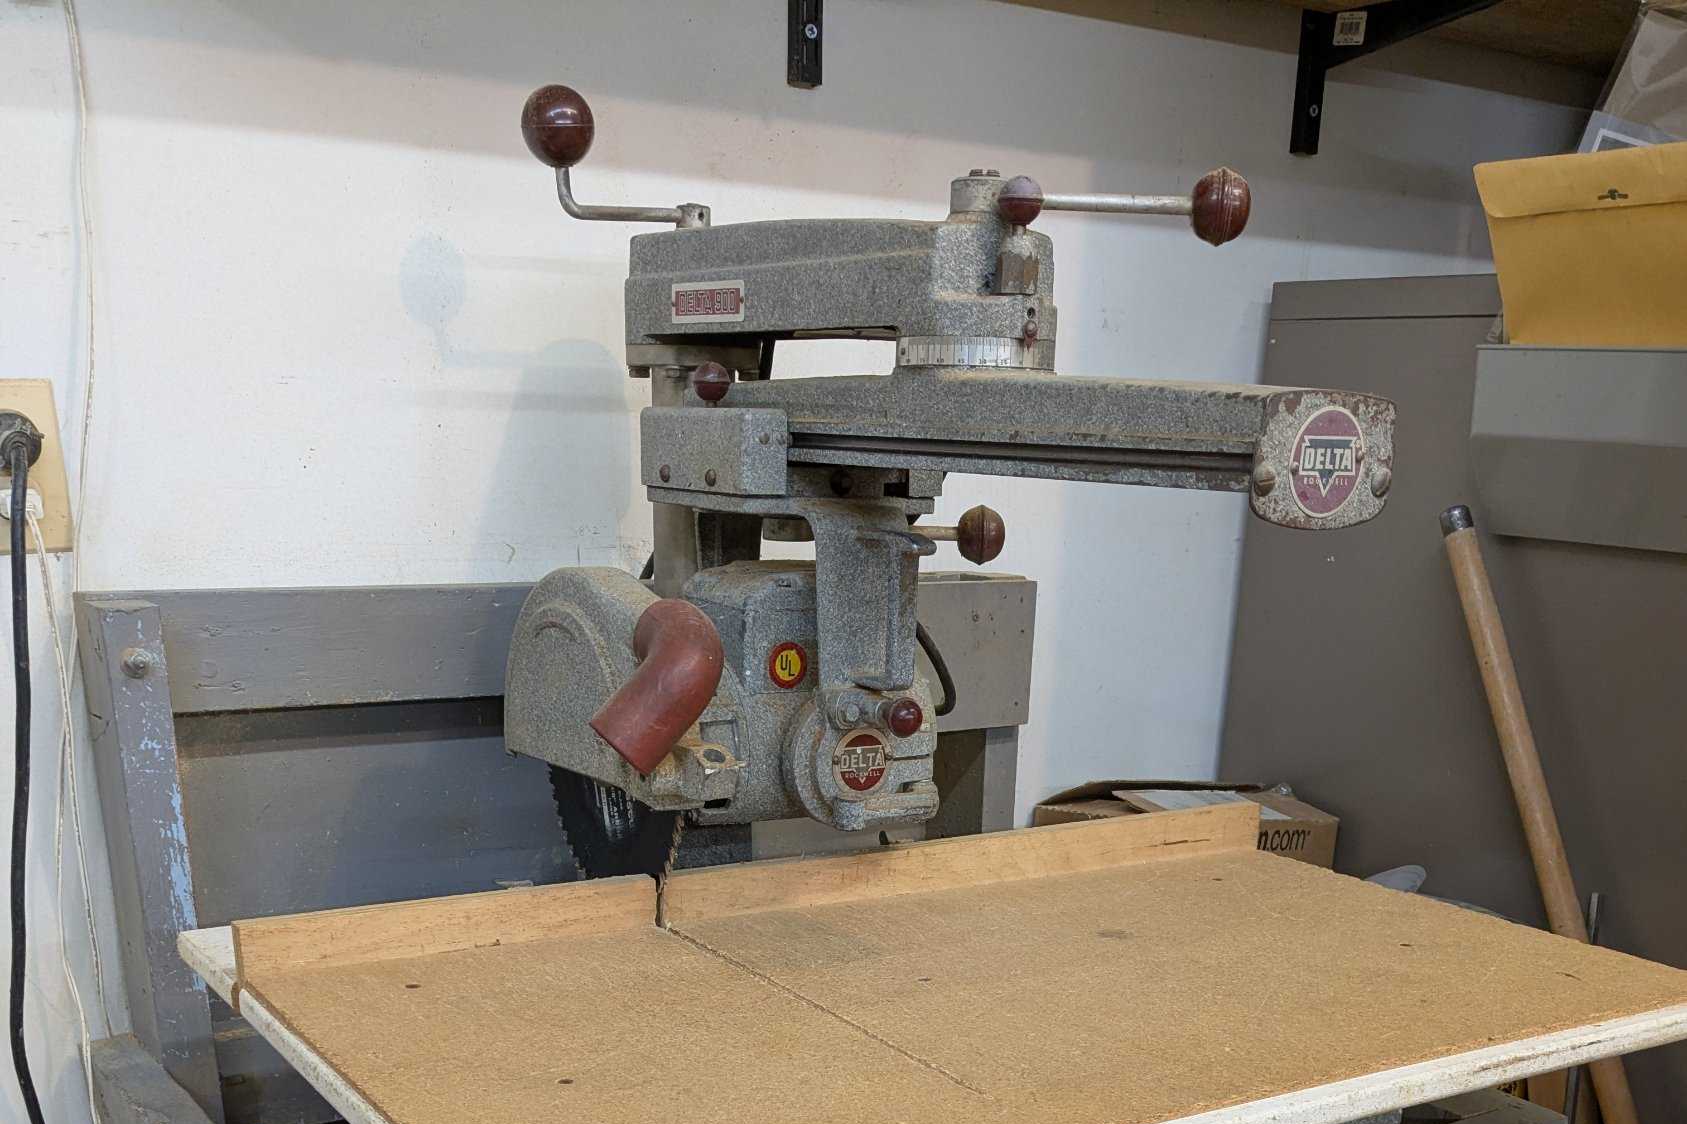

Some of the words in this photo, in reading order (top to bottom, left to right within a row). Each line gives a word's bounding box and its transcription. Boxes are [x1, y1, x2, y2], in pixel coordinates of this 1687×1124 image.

[679, 290, 712, 314] DELTA
[715, 289, 736, 313] 900
[1303, 448, 1352, 470] DELTA
[780, 654, 795, 677] UL
[840, 752, 883, 769] DELTA
